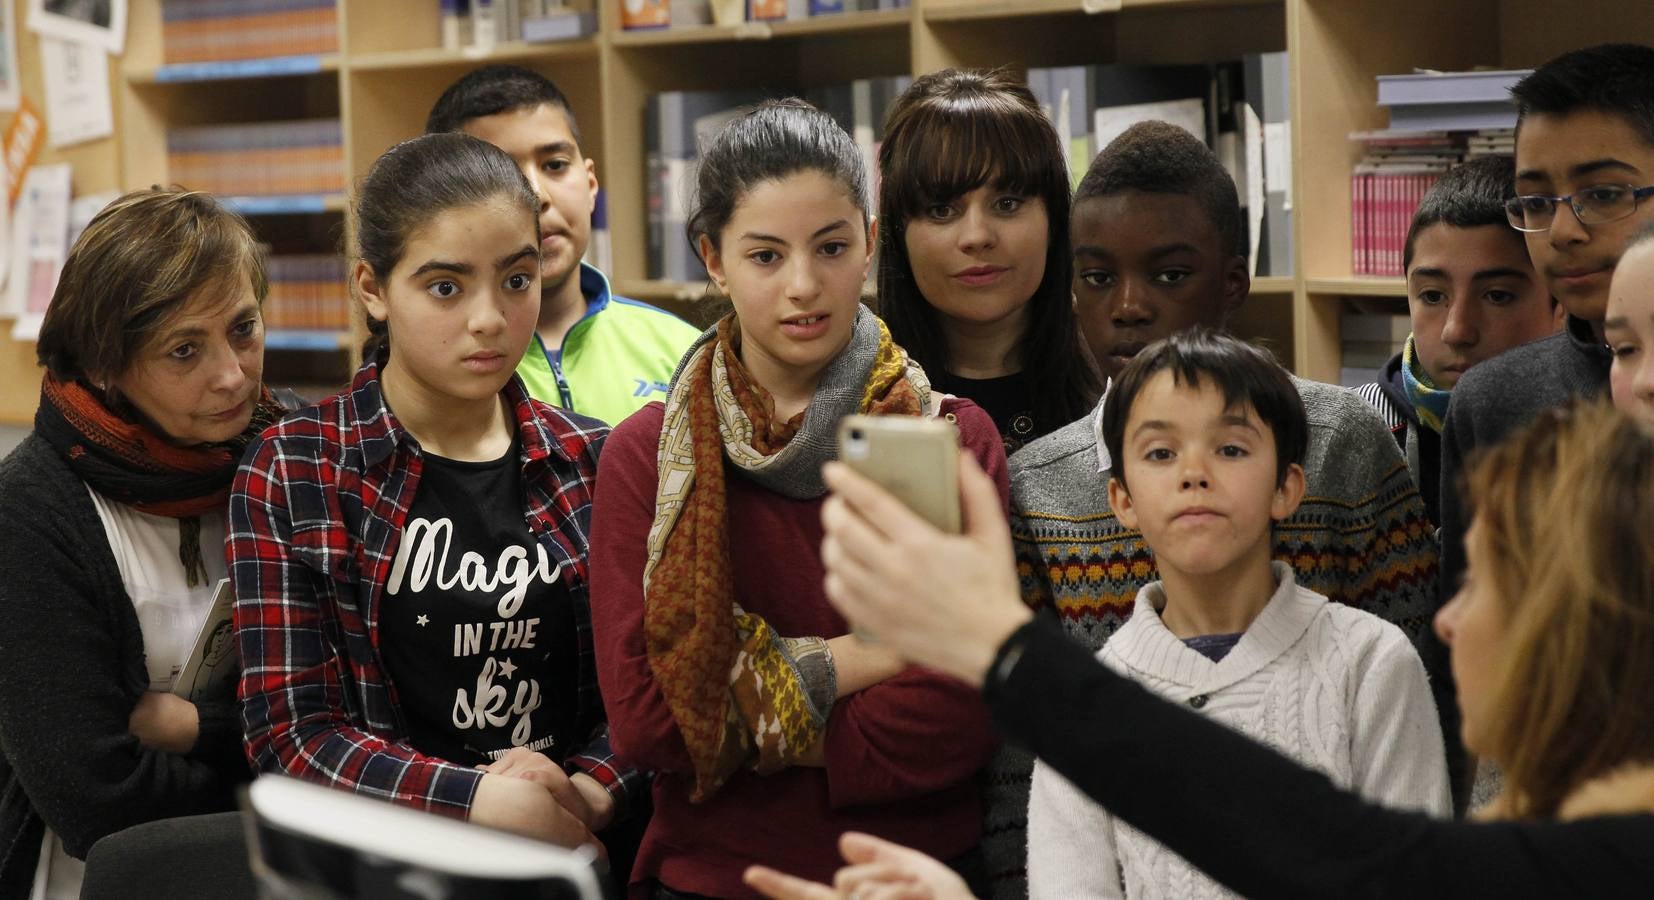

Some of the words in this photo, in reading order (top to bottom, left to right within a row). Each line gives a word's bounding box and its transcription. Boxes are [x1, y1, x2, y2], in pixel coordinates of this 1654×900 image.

[387, 517, 561, 619] Magi
[453, 622, 483, 657] IN
[489, 617, 540, 651] THE
[452, 656, 542, 745] sky
